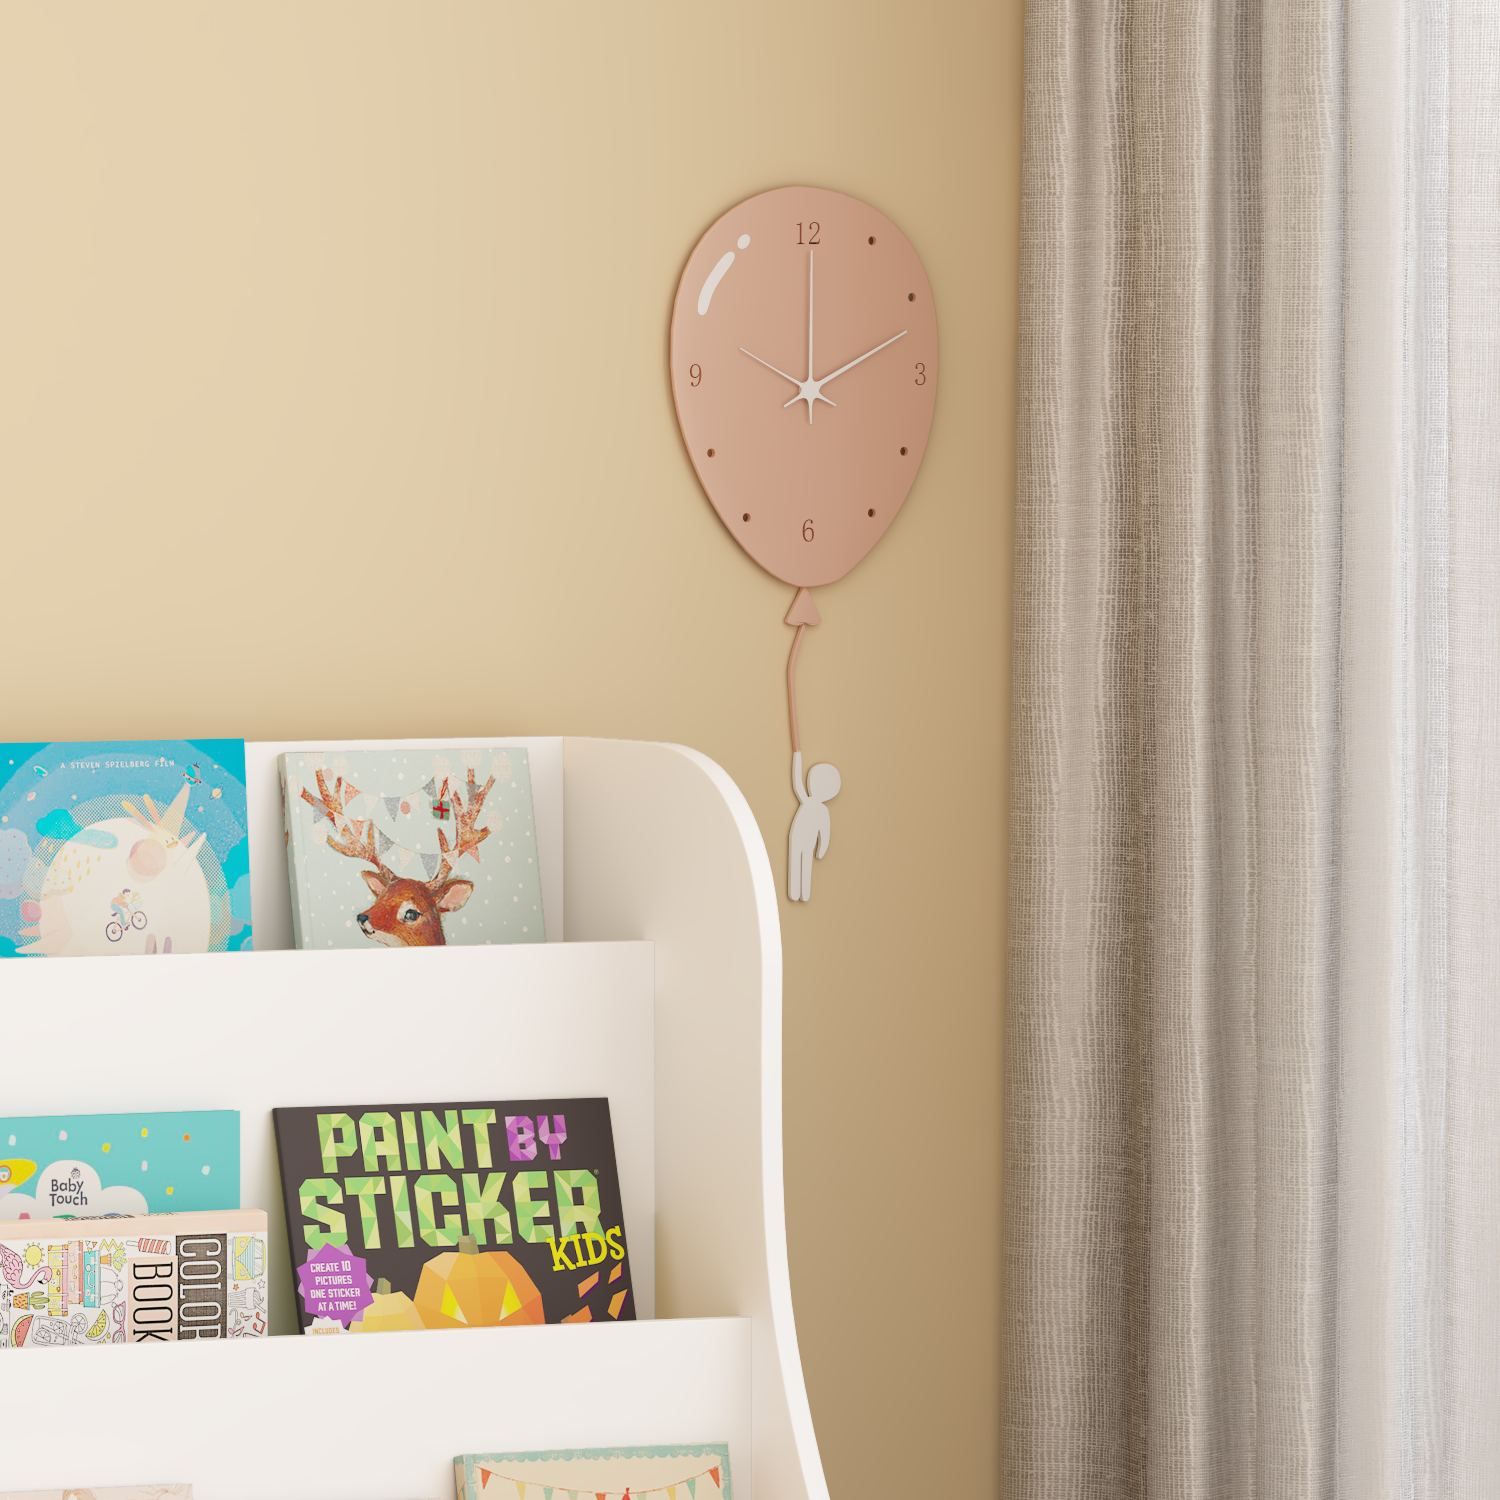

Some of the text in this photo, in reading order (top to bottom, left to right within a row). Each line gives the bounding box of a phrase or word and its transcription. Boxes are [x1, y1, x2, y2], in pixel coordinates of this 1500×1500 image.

[796, 221, 821, 245] 12
[689, 363, 702, 388] 9
[914, 362, 928, 386] 3
[802, 519, 815, 543] 6
[70, 761, 100, 769] STEVEN
[105, 760, 150, 768] SPIELBERG
[154, 759, 175, 767] FILM
[316, 1108, 568, 1174] PAINT BY
[51, 1178, 84, 1195] Baby
[49, 1191, 88, 1207] Touch
[298, 1169, 606, 1251] STICKER
[546, 1225, 625, 1272] KIDS
[310, 1260, 351, 1273] CREATE 10
[315, 1275, 353, 1286] PICTURES
[310, 1287, 361, 1299] ONE STICKER
[317, 1301, 357, 1312] AT A TIME!
[312, 1327, 340, 1335] INCLUDES
